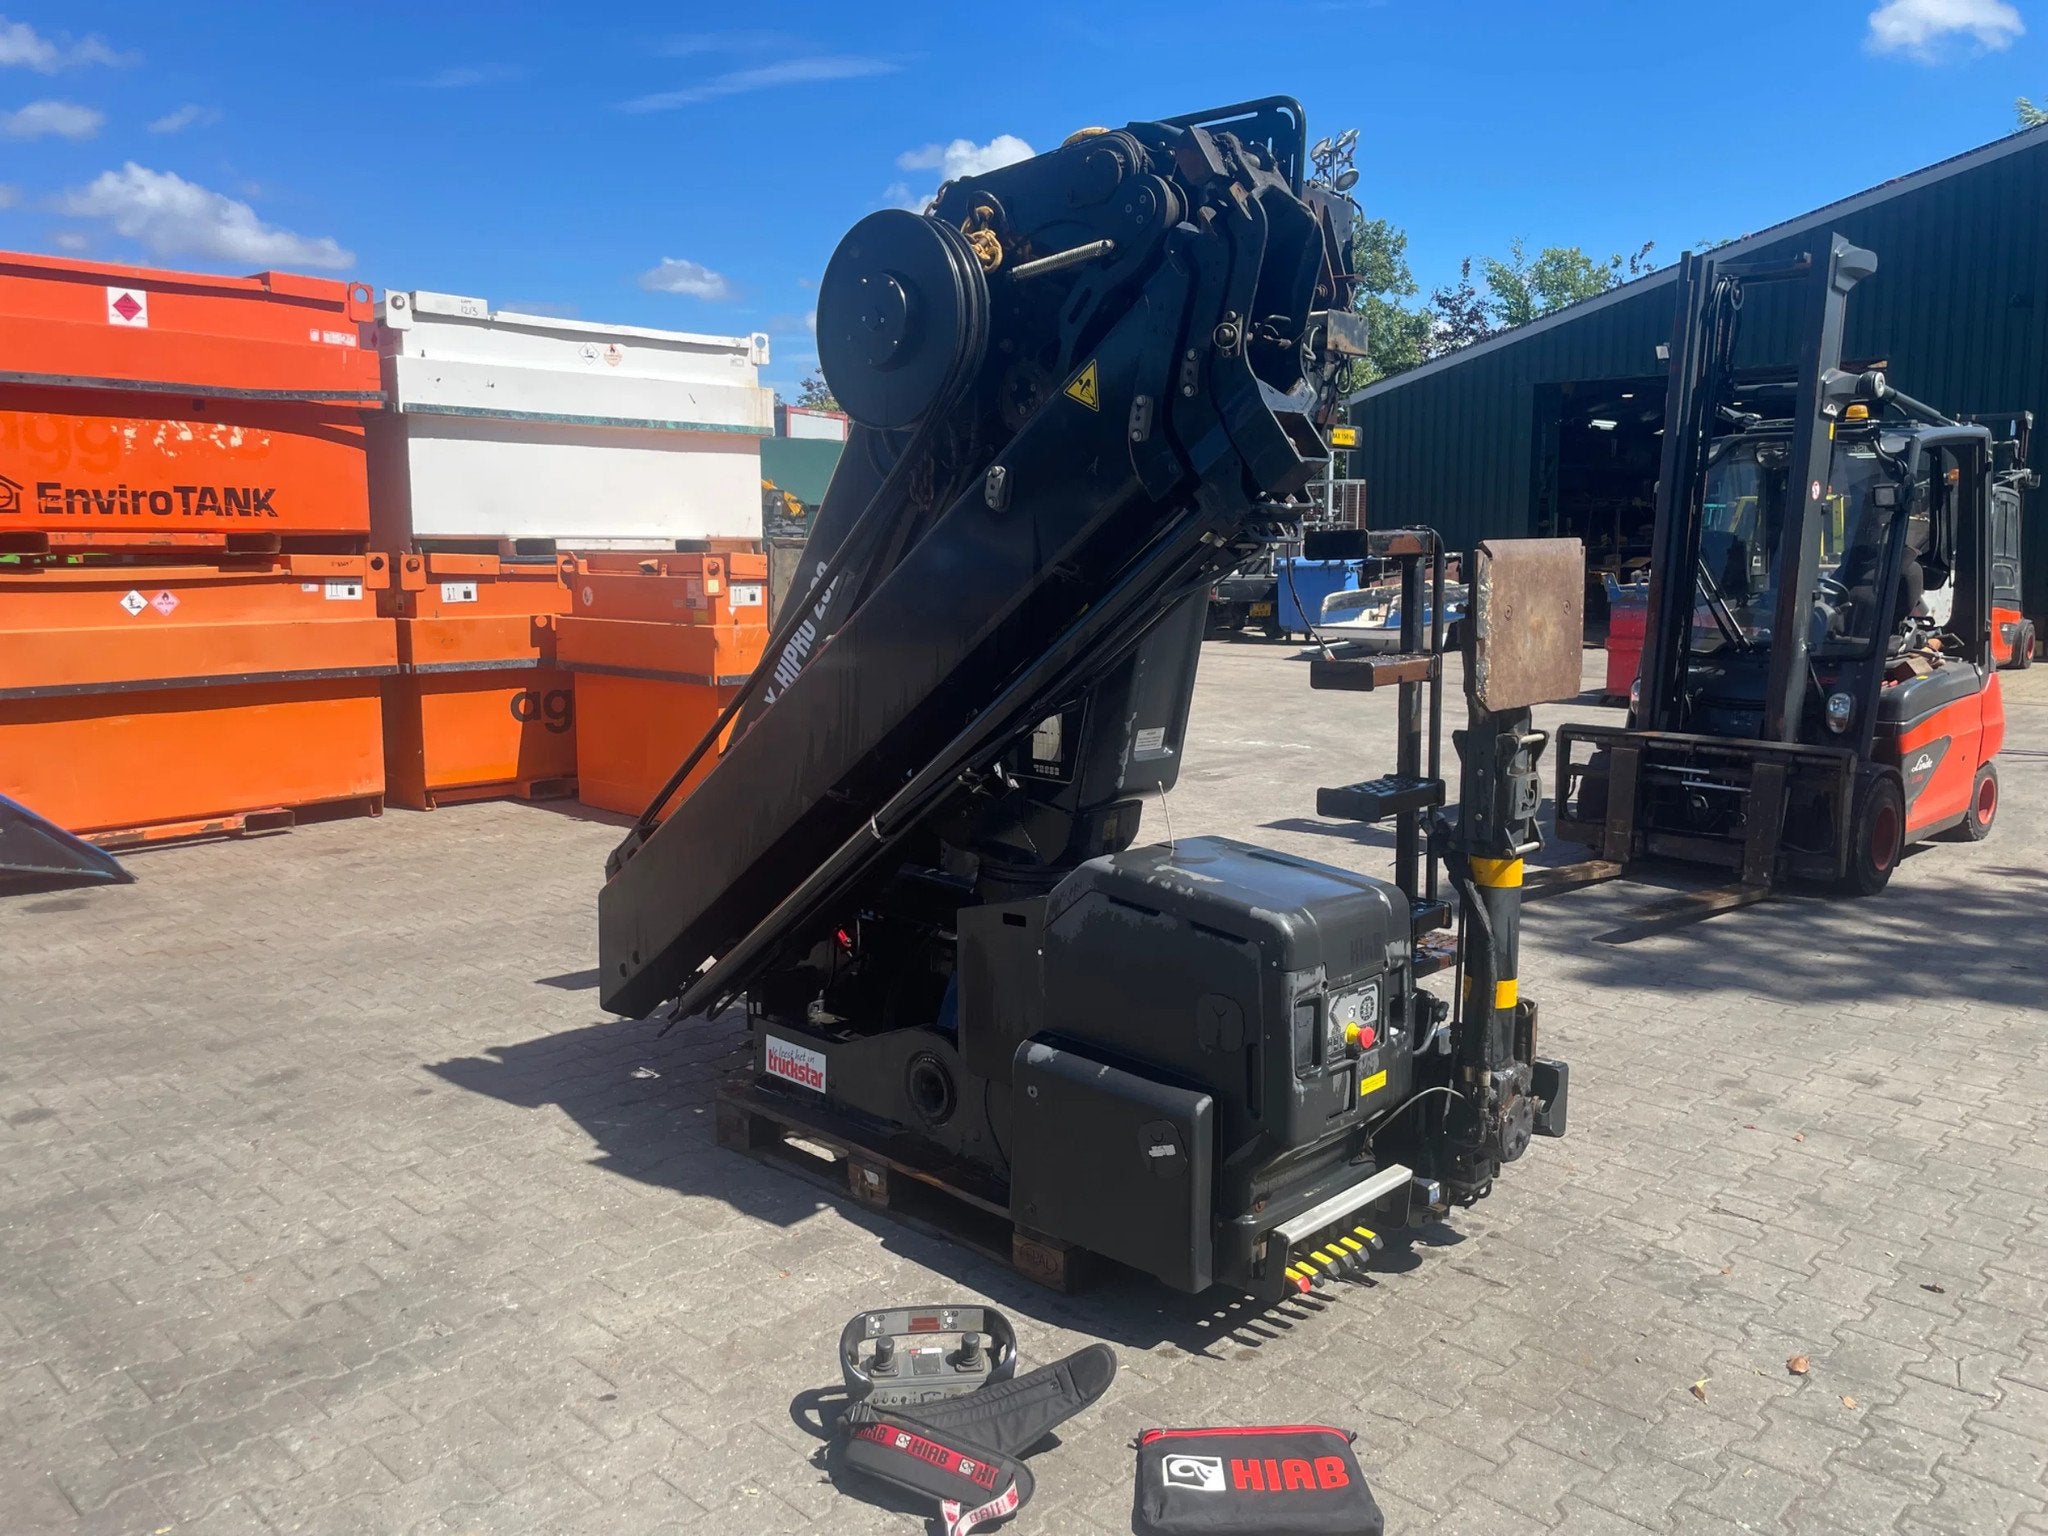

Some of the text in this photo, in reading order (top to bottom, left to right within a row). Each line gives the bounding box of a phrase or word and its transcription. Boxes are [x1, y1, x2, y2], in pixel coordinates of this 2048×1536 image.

[36, 481, 279, 517] EnviroTANK
[1911, 753, 1934, 773] Linde
[768, 1048, 824, 1089] truckstar
[912, 1439, 949, 1465] HIAB
[1231, 1456, 1350, 1491] HIAB
